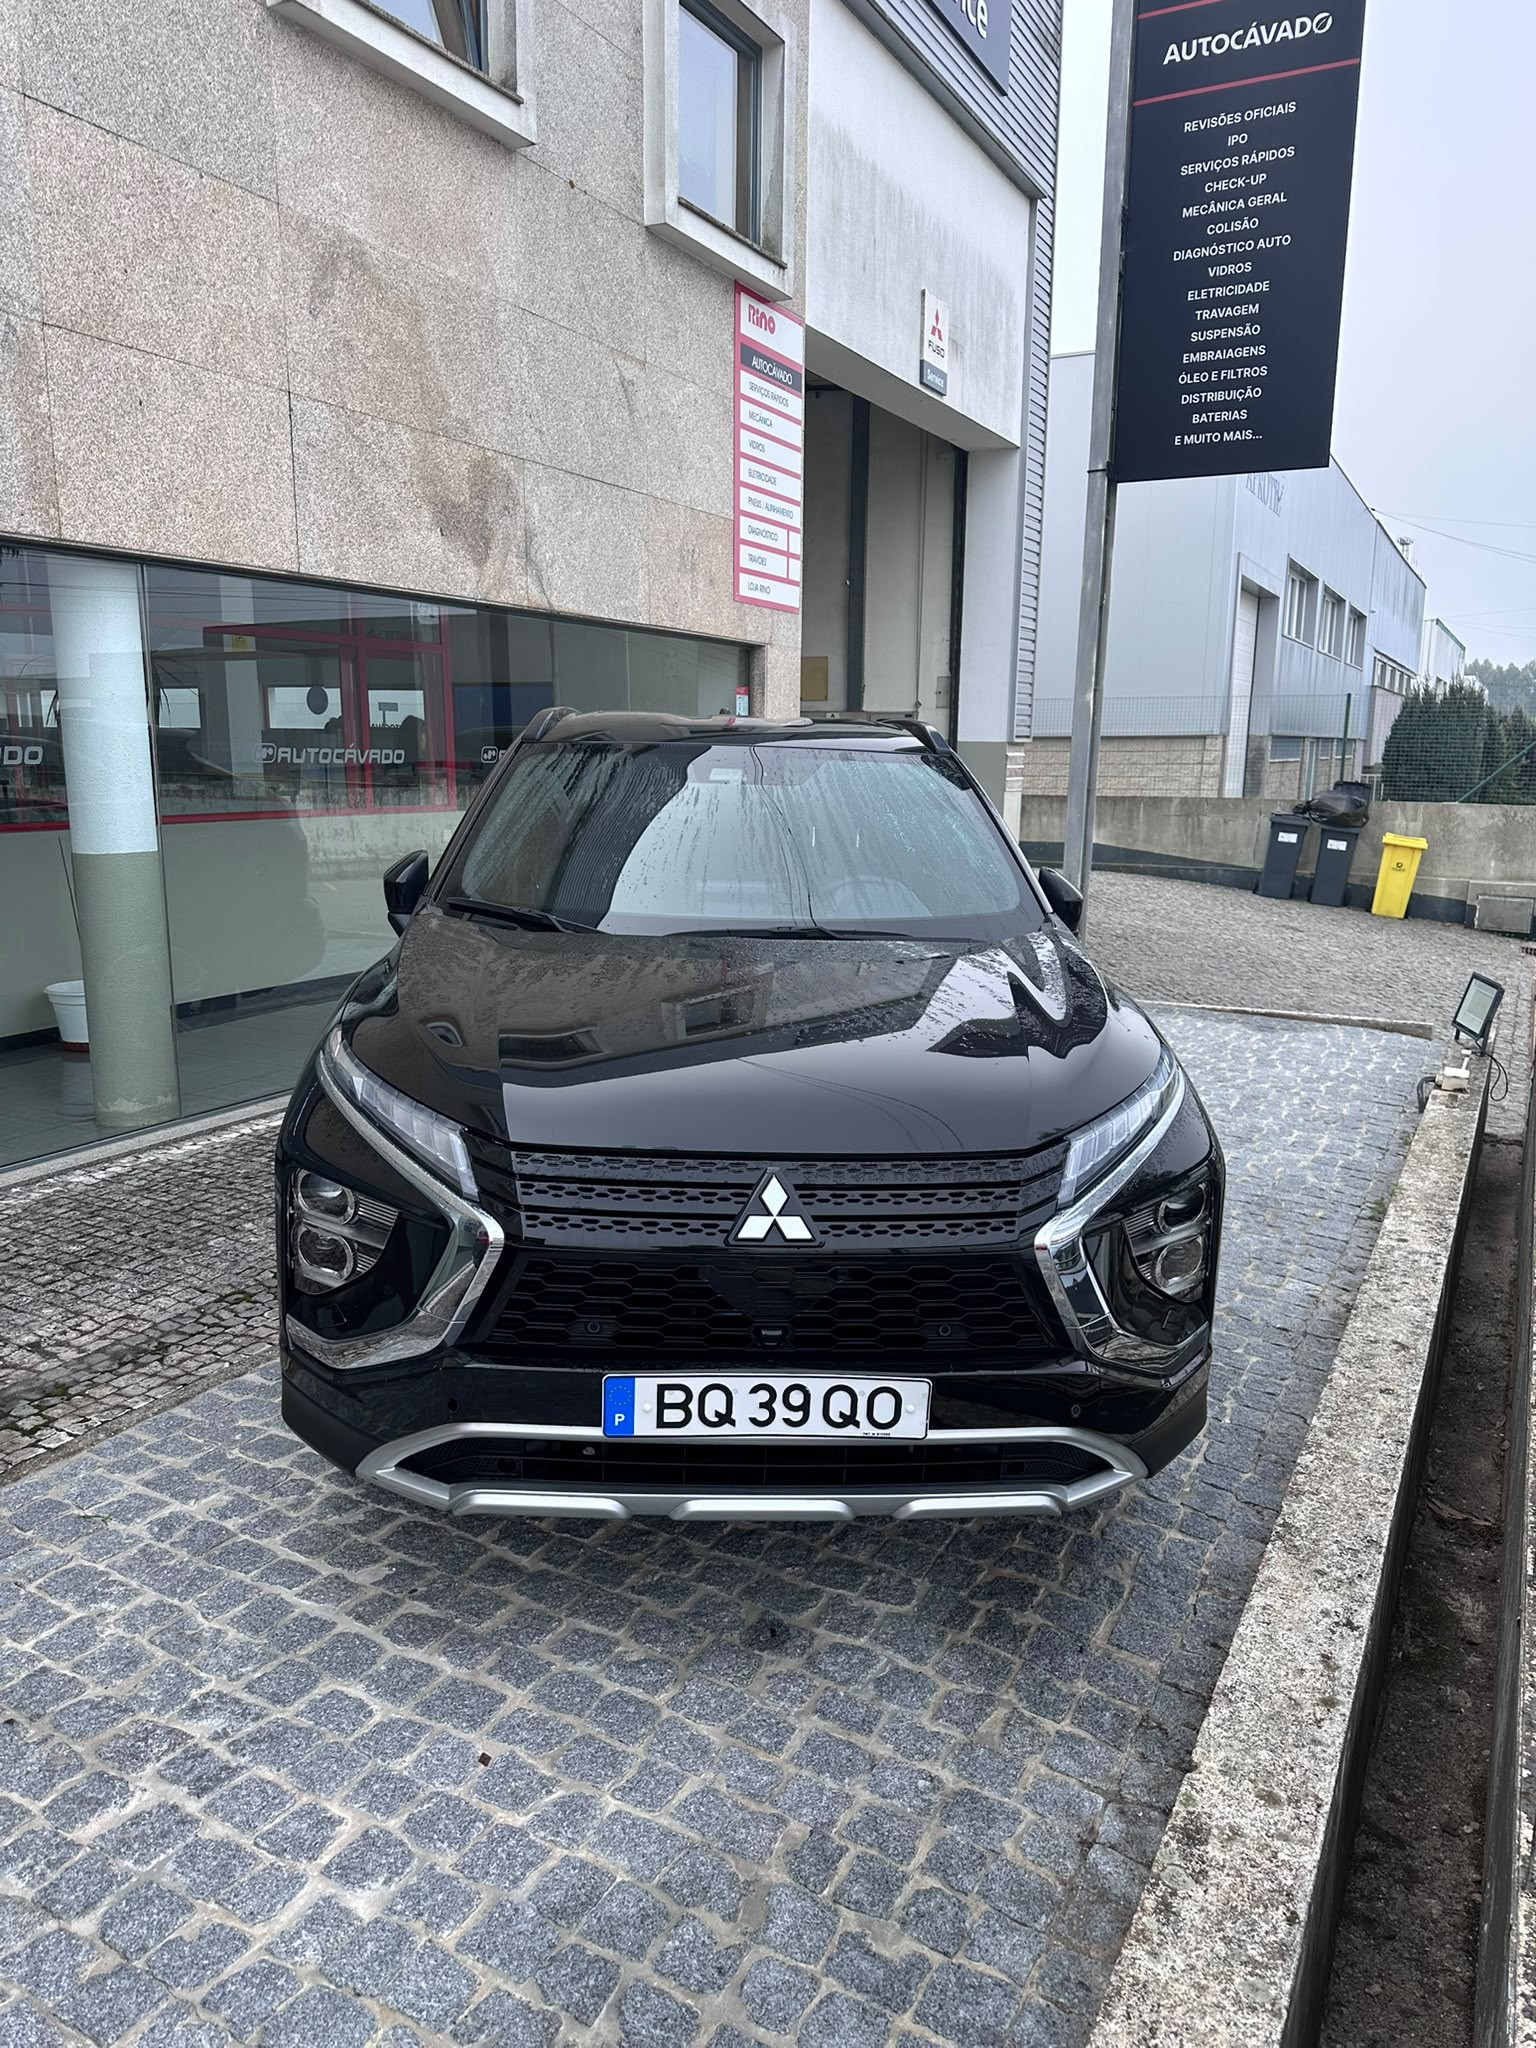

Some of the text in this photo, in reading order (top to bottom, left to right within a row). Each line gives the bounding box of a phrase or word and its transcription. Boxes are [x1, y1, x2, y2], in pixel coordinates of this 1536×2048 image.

[1163, 12, 1333, 65] AUTOCÁVADO
[1183, 101, 1297, 133] REVISÕES OFICIAIS
[1227, 133, 1248, 147] IPO
[1180, 146, 1295, 176] SERVIÇOS RÁPIDOS
[1204, 173, 1267, 193] CHECK-UP
[1182, 191, 1288, 218] MECÂNICA GERAL
[1206, 216, 1259, 235] COLISÃO
[1173, 234, 1292, 261] DIAGNÓSTICO AUTO
[1207, 261, 1252, 278] VIDROS
[1187, 280, 1270, 302] ELETRICIDADE
[1195, 304, 1260, 321] TRAVAGEM
[1190, 323, 1261, 343] SUSPENSÃO
[928, 340, 945, 358] FUSO
[1182, 345, 1267, 364] EMBRAIAGENS
[751, 355, 793, 386] AUTOCÁVADO
[1178, 366, 1268, 385] ÓLEO E FILTROS
[1181, 387, 1262, 405] DISTRIBUIÇÃO
[748, 409, 774, 428] MECÂNICA
[1192, 409, 1248, 424] BATERIAS
[748, 439, 766, 453] VIDROS
[1174, 429, 1263, 446] E MUITO MAIS...
[277, 743, 406, 765] AUTOCÁVADO
[655, 1382, 904, 1431] BQ 39 QO
[614, 1413, 626, 1427] P
